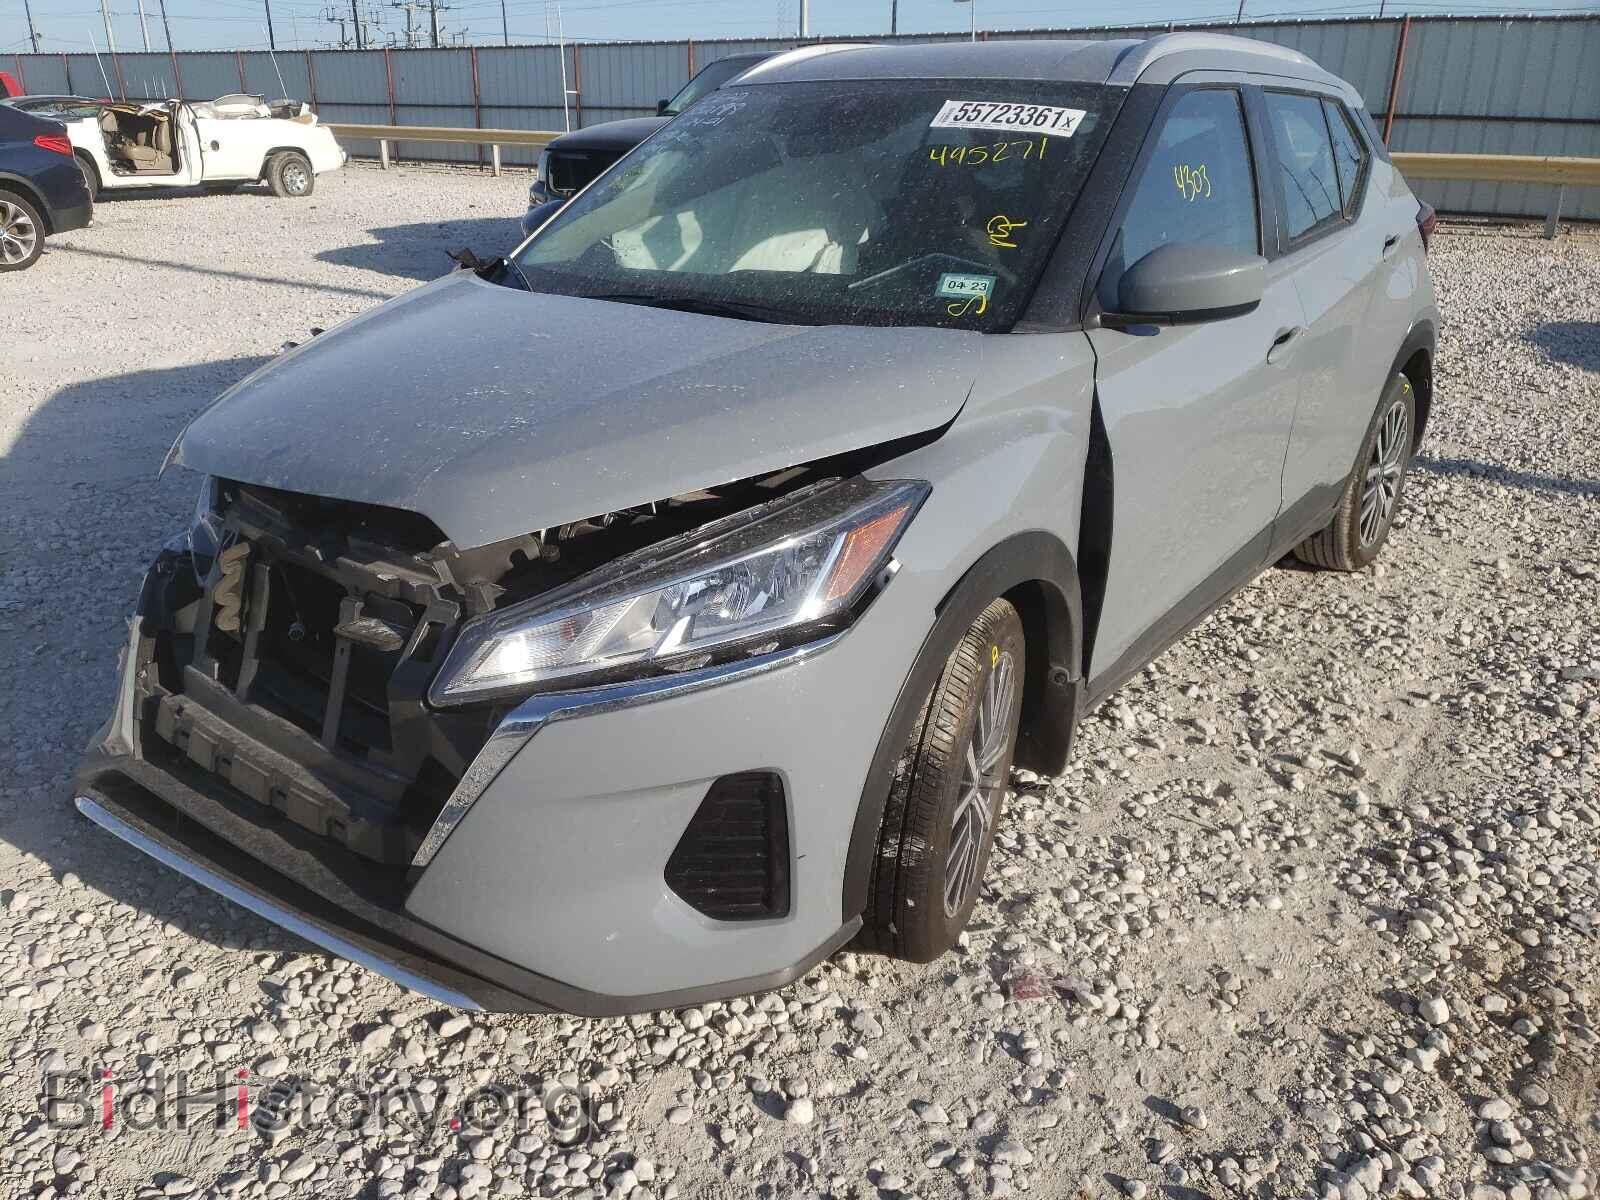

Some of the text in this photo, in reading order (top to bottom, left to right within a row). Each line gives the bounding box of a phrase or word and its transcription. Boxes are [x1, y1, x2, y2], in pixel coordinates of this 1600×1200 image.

[953, 102, 1065, 128] 55723361
[929, 137, 1048, 166] 495271
[1174, 164, 1211, 202] 4303
[947, 280, 987, 291] 04 23
